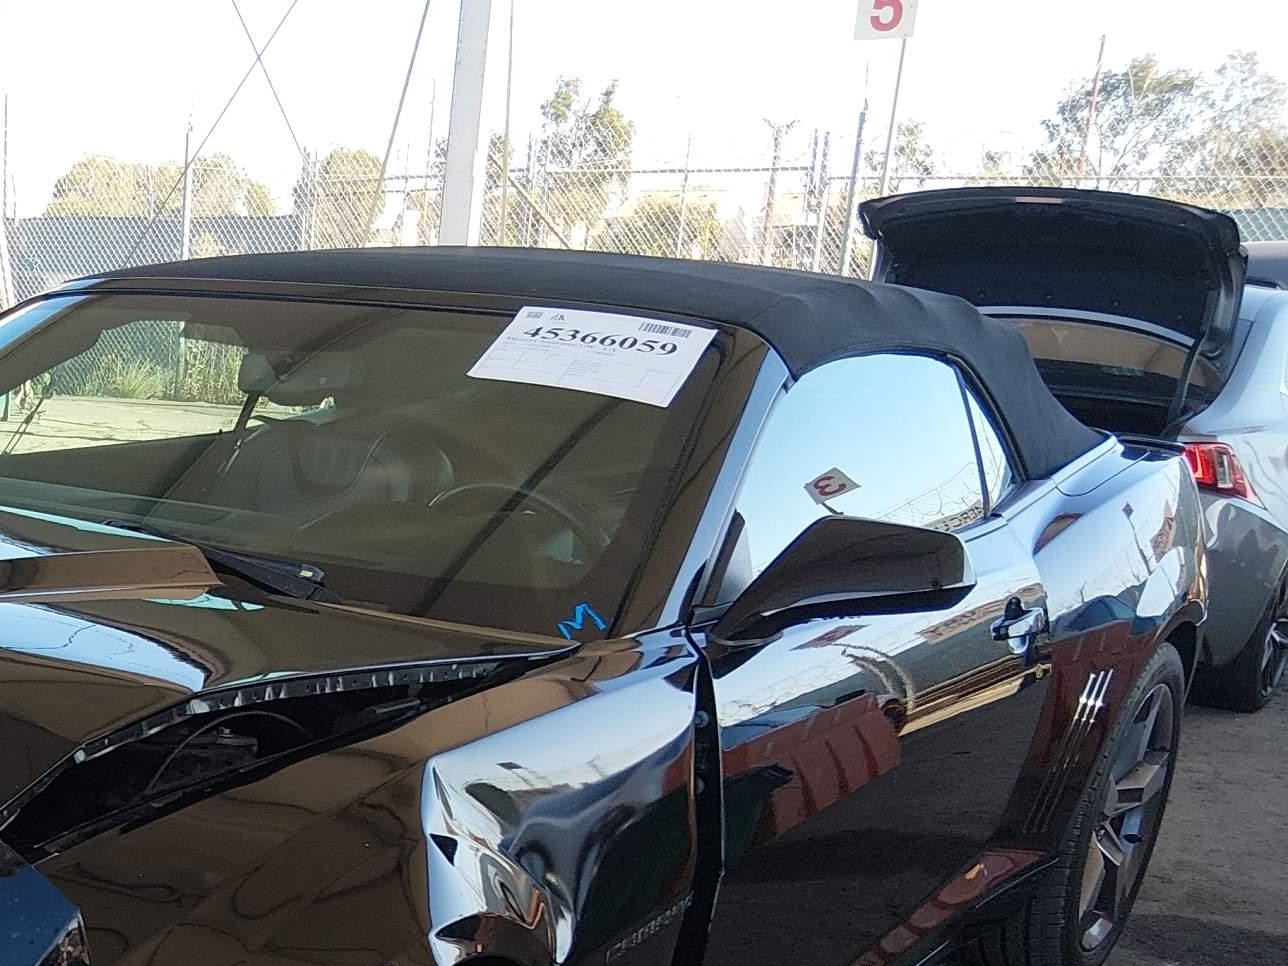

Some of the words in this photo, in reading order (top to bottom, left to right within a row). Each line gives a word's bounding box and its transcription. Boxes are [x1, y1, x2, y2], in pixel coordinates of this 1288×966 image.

[870, 0, 903, 31] 5
[523, 325, 678, 356] 45366059
[557, 602, 607, 640] M
